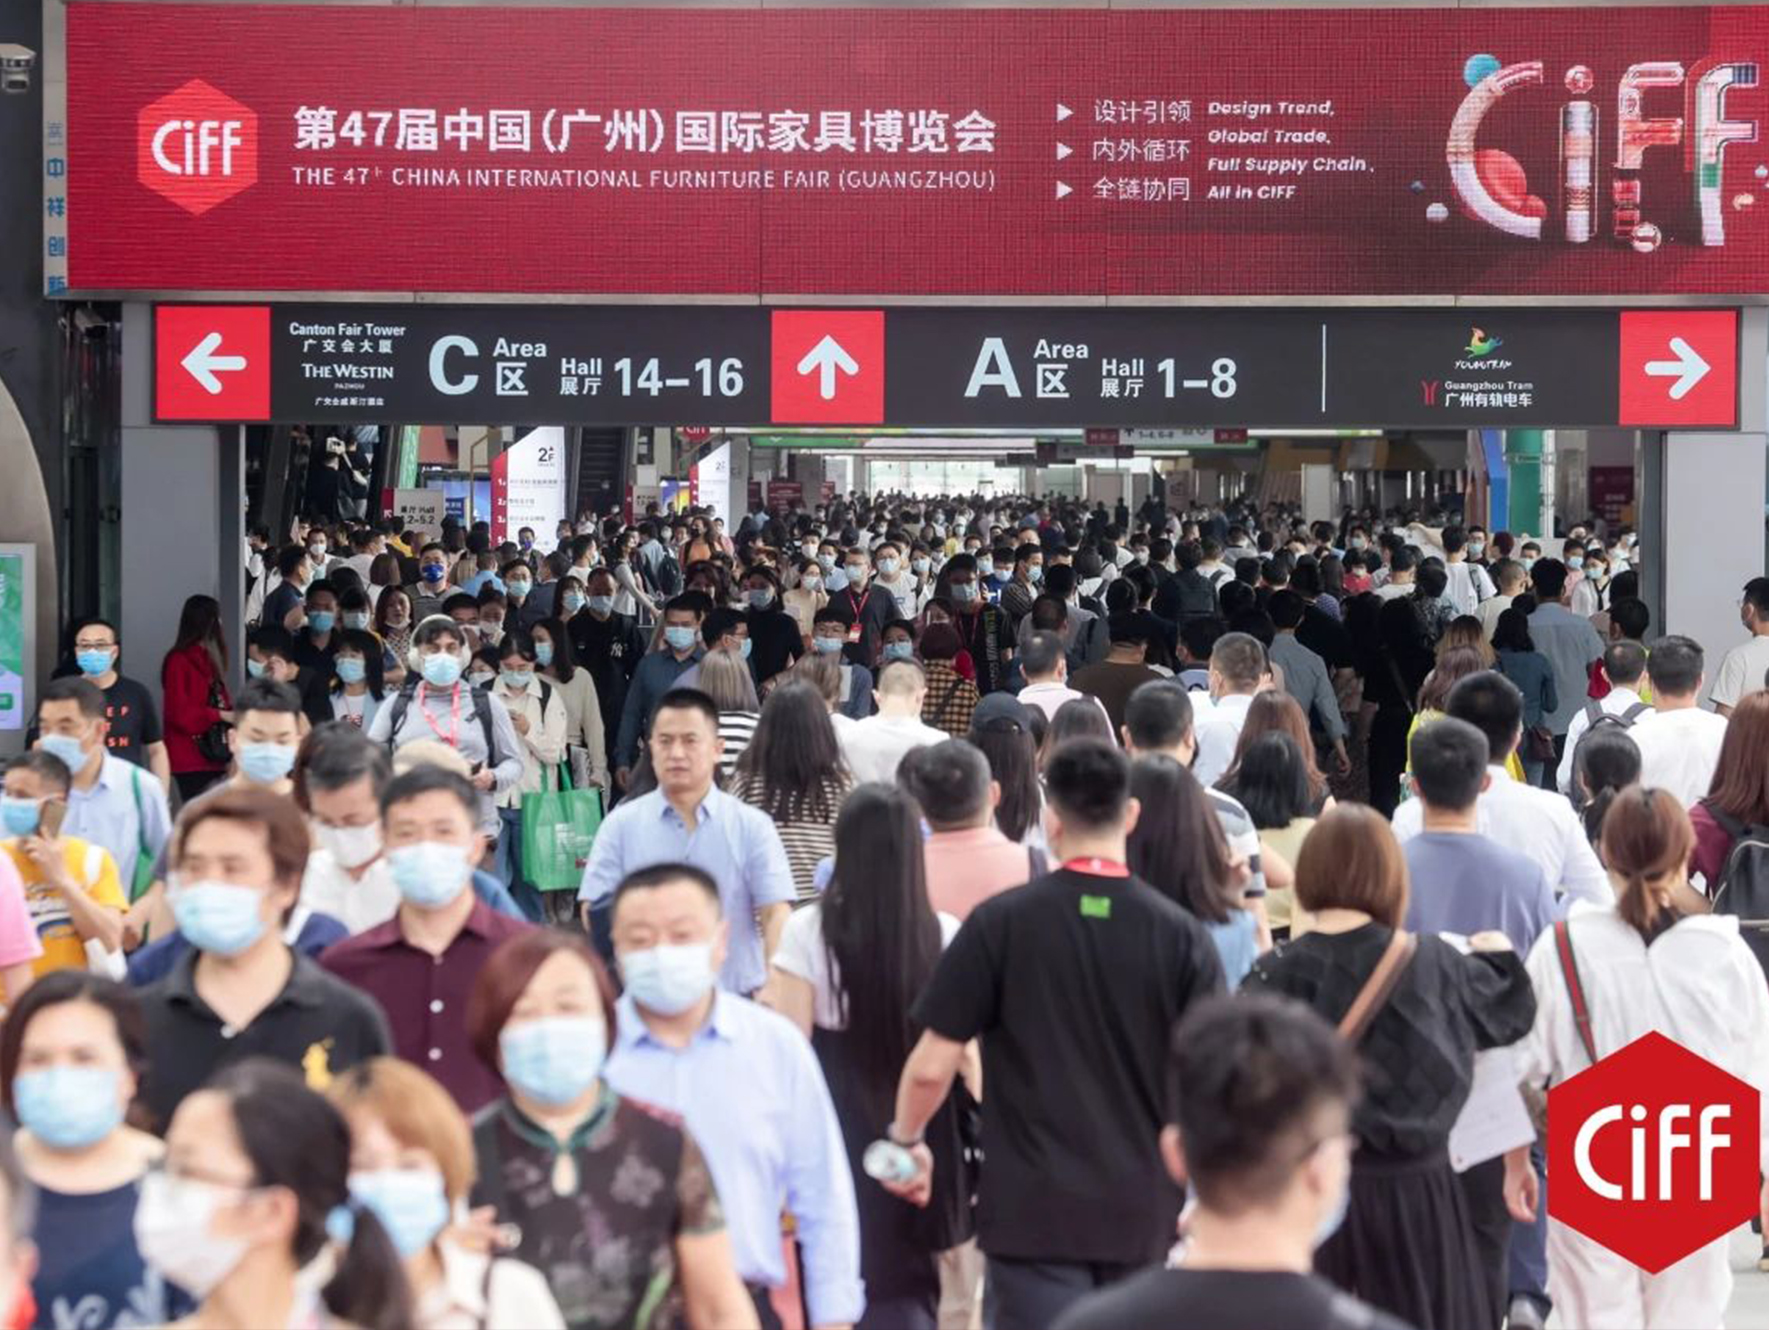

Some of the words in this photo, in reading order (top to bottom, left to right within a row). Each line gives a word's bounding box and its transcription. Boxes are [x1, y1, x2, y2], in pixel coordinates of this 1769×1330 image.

[1094, 100, 1191, 123] 设计引领
[1208, 101, 1272, 119] Design
[1278, 101, 1335, 117] Trend,
[1208, 129, 1269, 143] Global
[1274, 130, 1332, 145] Trade,
[1092, 138, 1191, 162] 内外循环
[1207, 157, 1241, 171] Full
[1245, 157, 1308, 175] Supply
[293, 167, 335, 185] THE
[392, 168, 460, 186] CHINA
[467, 169, 642, 187] INTERNATIONAL
[650, 170, 775, 188] FURNITURE
[784, 170, 830, 188] FAIR
[839, 170, 995, 191] (GUANGZHOU)
[1093, 177, 1190, 200] 全链协同
[1207, 186, 1231, 199] All
[1235, 185, 1253, 199] in
[1257, 186, 1297, 199] CIFF
[289, 321, 336, 336] Canton
[338, 322, 363, 336] Fair
[365, 323, 406, 337] Tower
[303, 338, 393, 354] 广交会大厦
[493, 338, 547, 358] Area
[1033, 339, 1089, 359] Area
[302, 363, 332, 378] THE
[332, 365, 394, 379] WESTIN
[429, 335, 479, 395] C
[963, 337, 1022, 397] A
[496, 361, 529, 396] 区
[560, 358, 603, 376] Hall
[613, 357, 744, 397] 14-16
[560, 376, 602, 395] 展厅
[1036, 363, 1070, 398] 区
[1101, 357, 1145, 377] Hall
[1157, 357, 1237, 398] 1-8
[1444, 381, 1505, 392] Guangzhou
[1507, 381, 1534, 391] Tram
[1100, 377, 1144, 398] 展厅
[1444, 392, 1533, 407] 广州有轨电车
